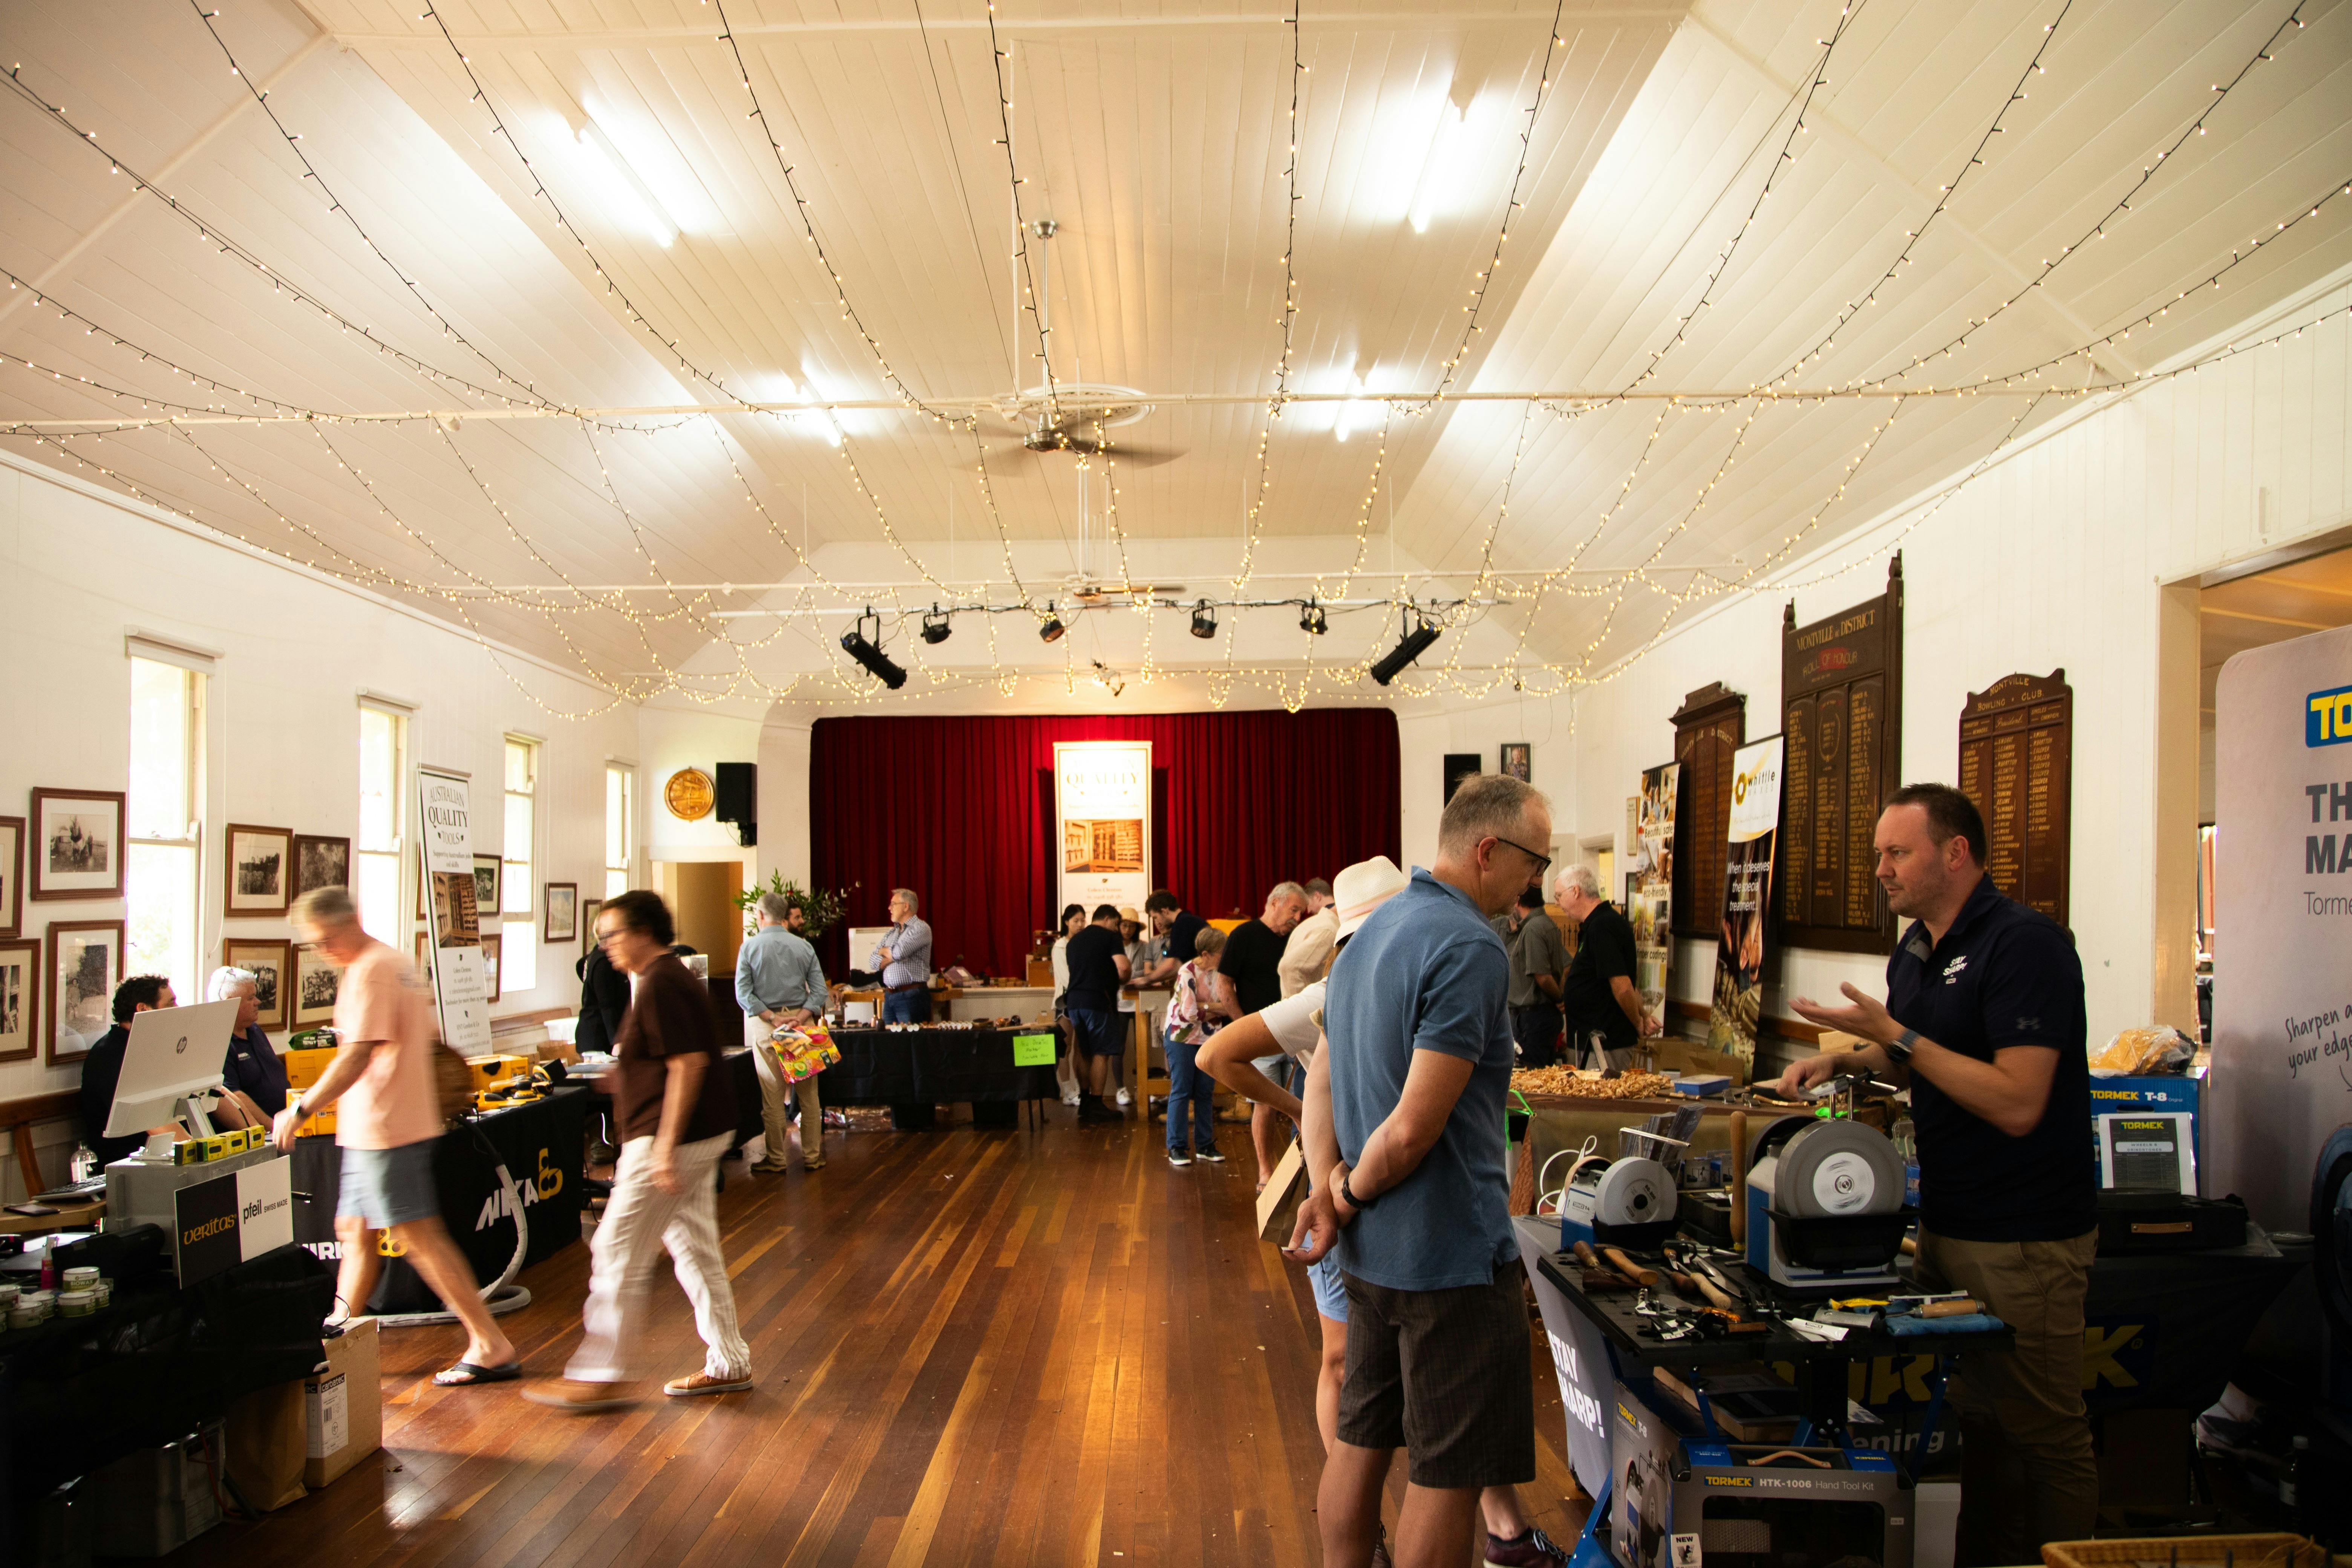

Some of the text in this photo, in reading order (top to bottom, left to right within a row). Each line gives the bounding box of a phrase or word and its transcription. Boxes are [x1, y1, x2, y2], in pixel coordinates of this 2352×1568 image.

[1797, 625, 1833, 652] MONTVILLE
[1841, 609, 1875, 636] DISTRICT
[1822, 652, 1831, 666] OF
[1833, 651, 1858, 665] HONOUR
[1989, 678, 2029, 697] MONTVILLE
[1977, 689, 2042, 712] BOWLING CLUB
[1748, 770, 1775, 788] whittle
[430, 786, 465, 808] AUSTRALIAN
[429, 806, 468, 828] QUALITY
[441, 830, 460, 845] TOOLS
[1663, 823, 1673, 835] safe
[1727, 859, 1770, 874] When it deserves
[1732, 877, 1761, 895] the special
[1649, 949, 1667, 962] coatings
[2285, 1010, 2340, 1044] Sharpen
[2288, 1046, 2317, 1079] your
[2090, 1090, 2139, 1100] TORMEK
[2145, 1092, 2167, 1102] T-8
[2121, 1121, 2164, 1130] TORMEK
[243, 1199, 288, 1224] pfeil SWISS MADE
[1548, 1329, 1579, 1383] STAY
[322, 1375, 345, 1392] carbatec
[1638, 1420, 1647, 1438] T-8
[1705, 1476, 1874, 1490] TORMEK HTK-1006 Hand Tool Kit
